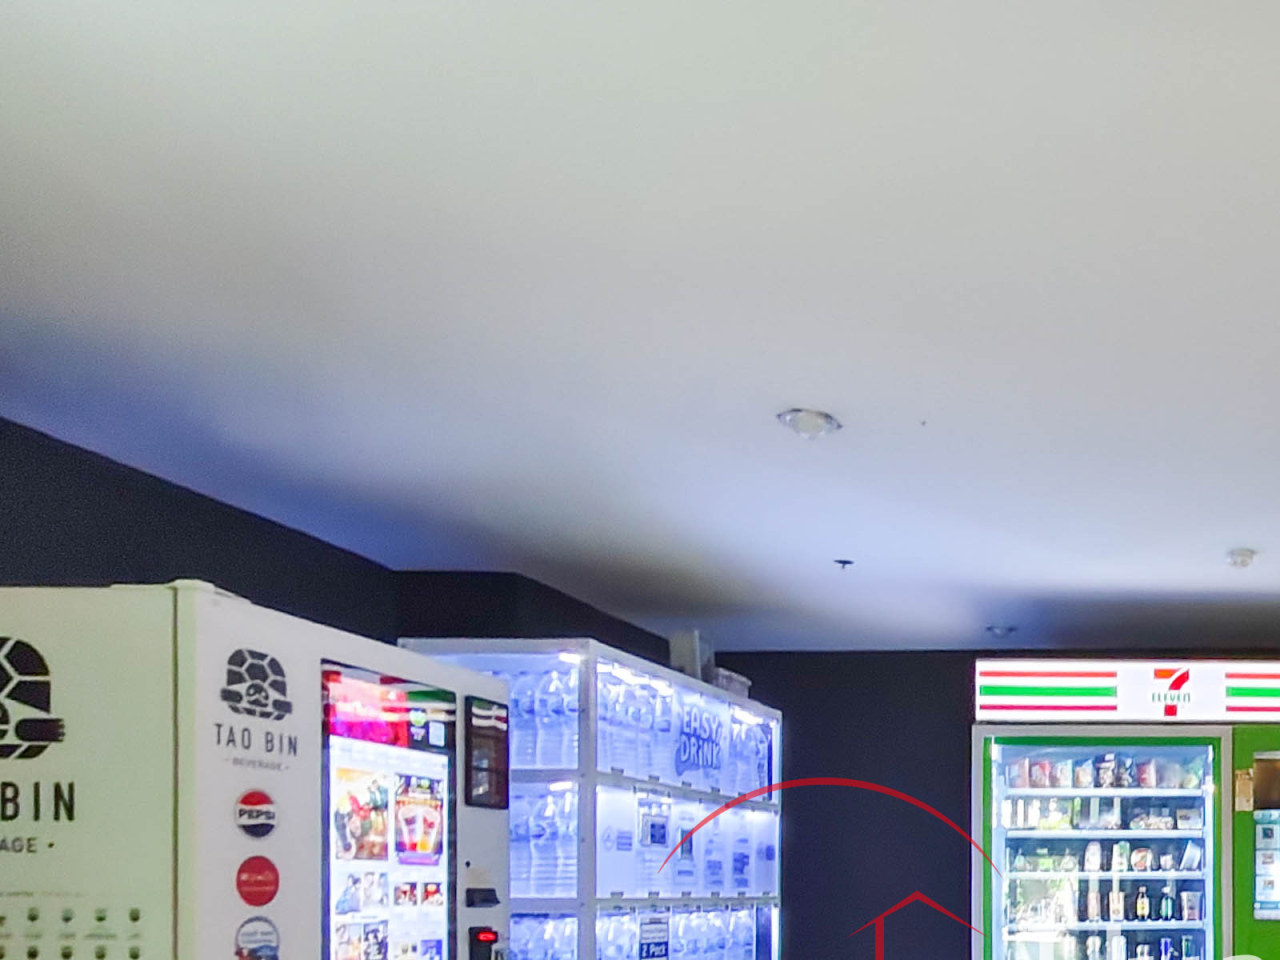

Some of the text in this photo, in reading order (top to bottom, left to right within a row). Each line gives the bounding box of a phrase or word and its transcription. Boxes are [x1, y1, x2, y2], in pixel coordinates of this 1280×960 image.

[213, 723, 298, 757] TAO BIN
[683, 706, 719, 740] EASY
[0, 781, 76, 822] BIN
[238, 808, 276, 820] PEPSI
